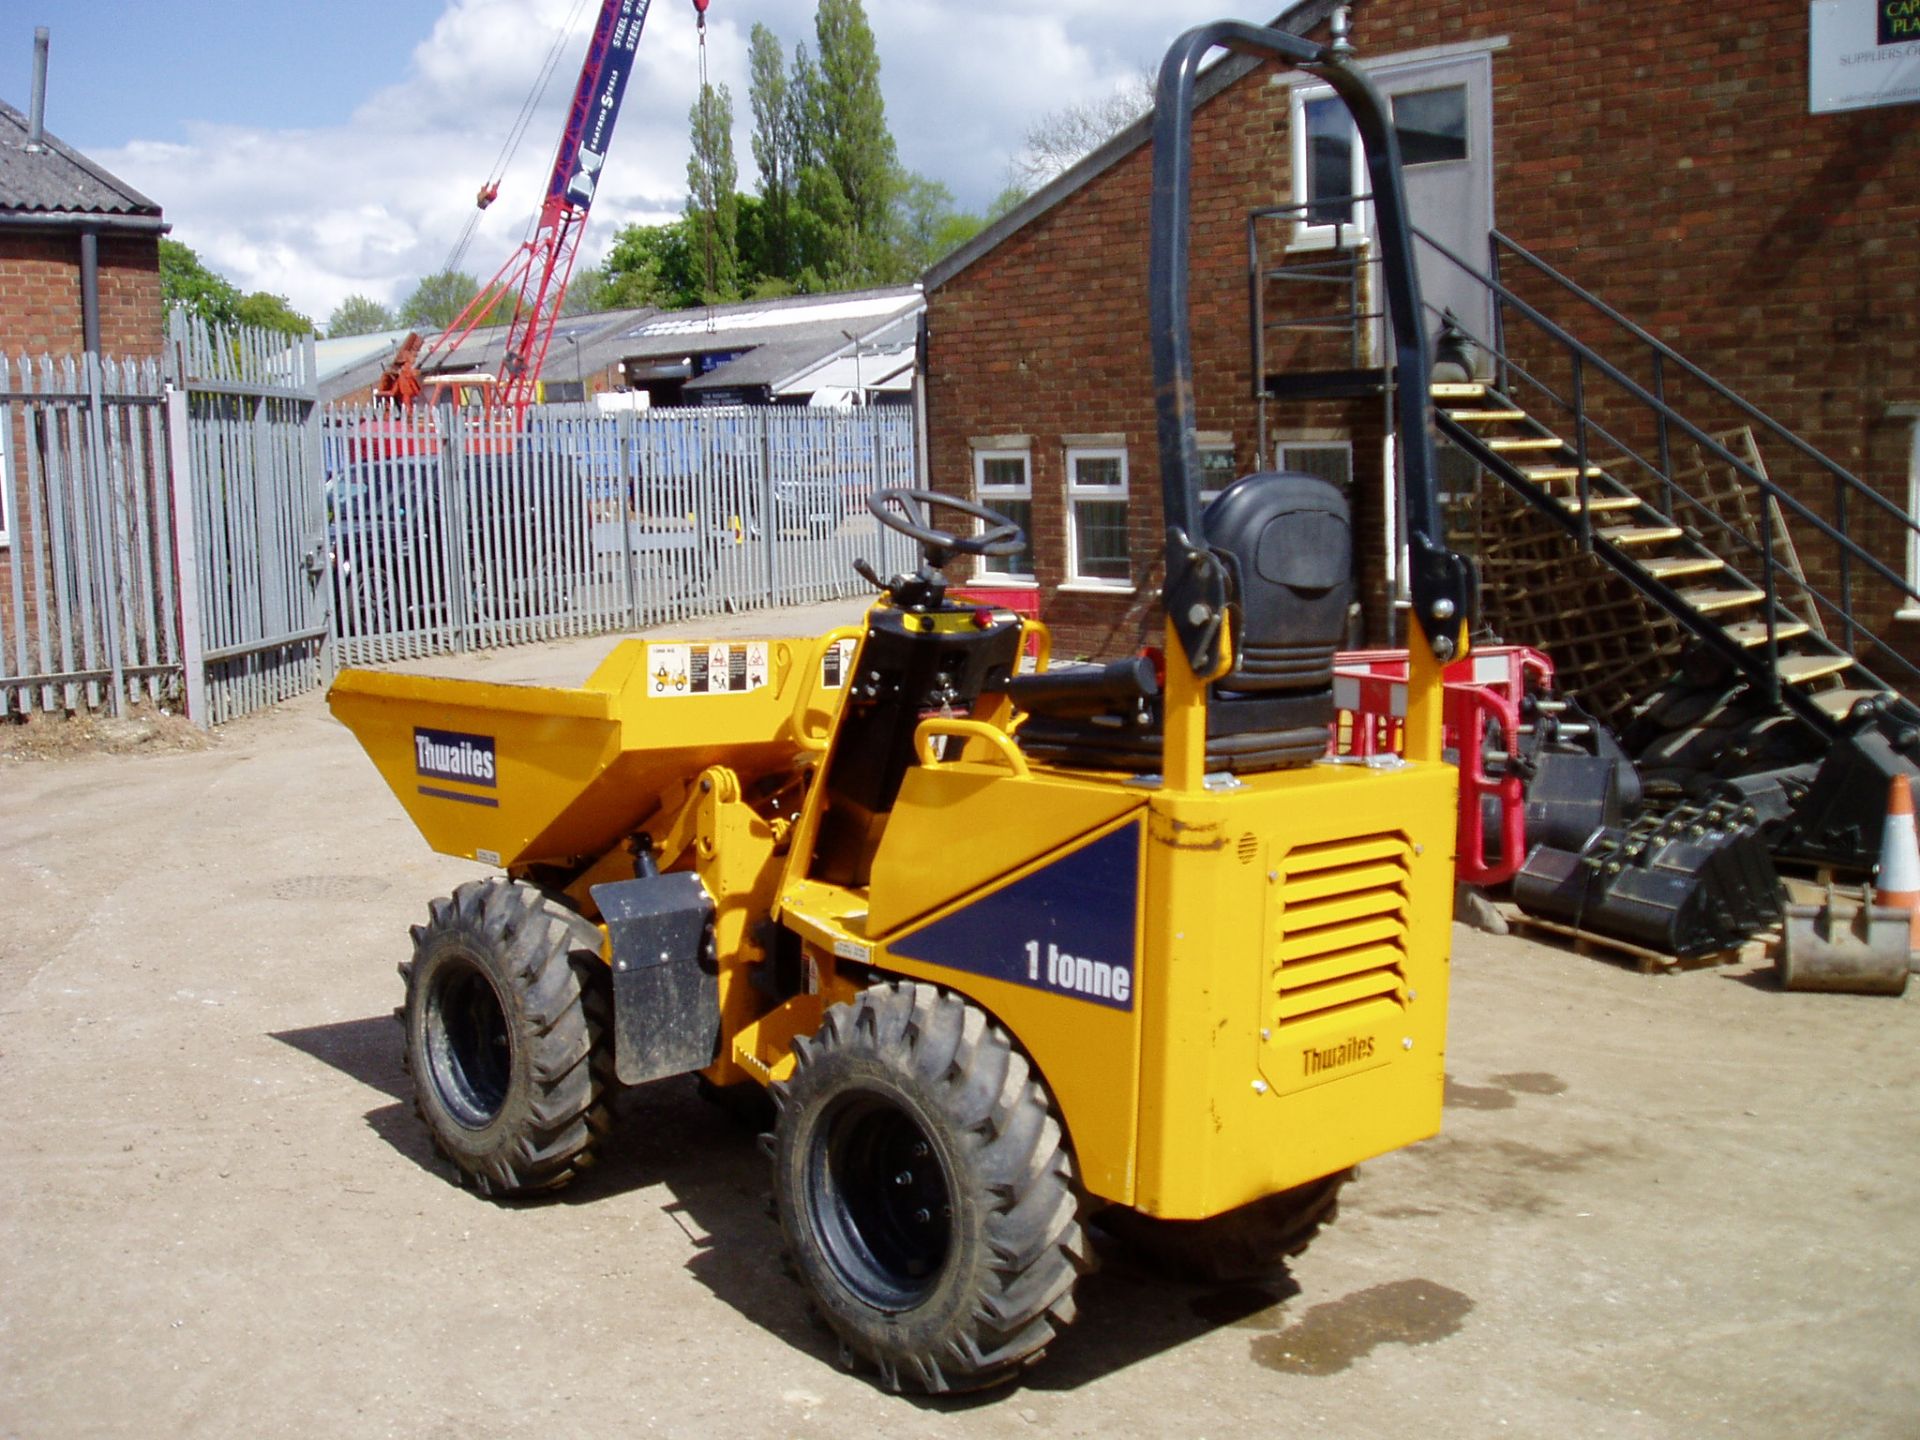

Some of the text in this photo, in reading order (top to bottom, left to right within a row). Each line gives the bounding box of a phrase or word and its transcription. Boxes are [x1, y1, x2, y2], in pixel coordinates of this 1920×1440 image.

[612, 16, 628, 48] STEEL
[626, 19, 641, 51] STEEL
[1840, 47, 1902, 66] SUPPLIERS
[415, 735, 494, 779] Thwaites
[1025, 939, 1131, 1002] 1 tonne
[1303, 1036, 1376, 1077] Thwaites
